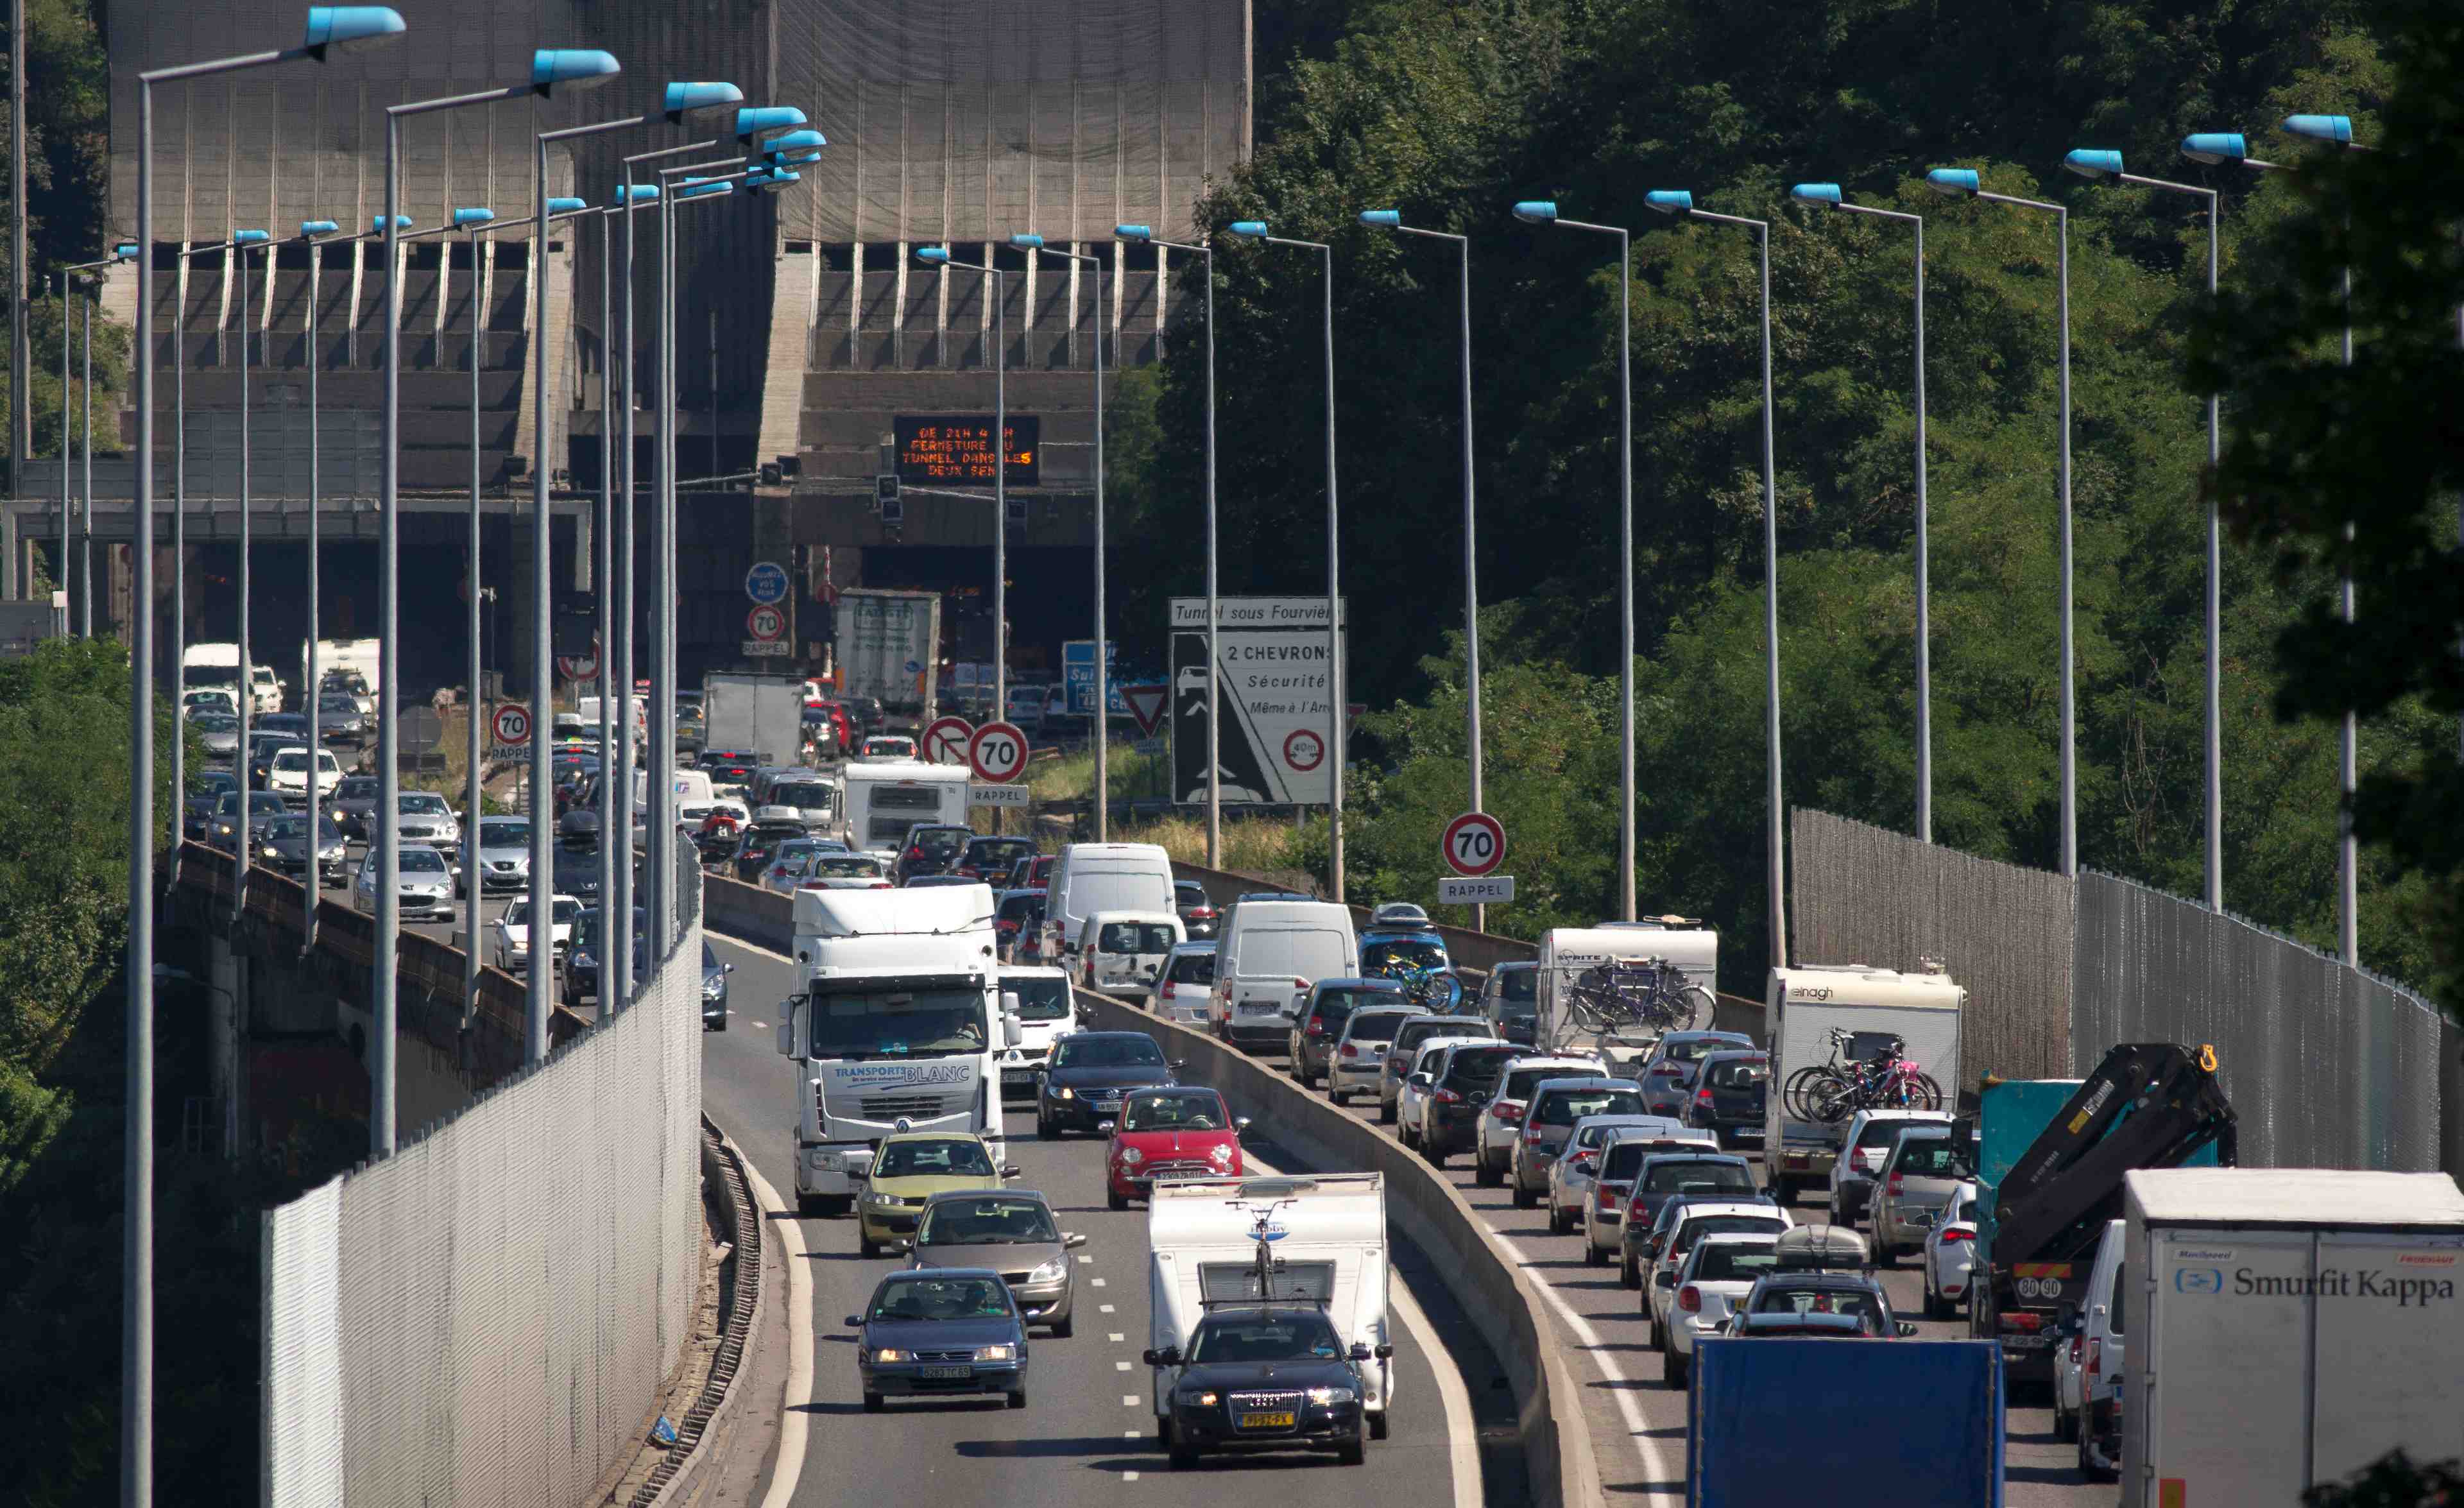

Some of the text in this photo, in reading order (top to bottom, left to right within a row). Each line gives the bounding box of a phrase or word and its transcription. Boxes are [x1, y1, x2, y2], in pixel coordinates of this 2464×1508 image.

[911, 440, 987, 452] FERMETURE
[903, 452, 955, 463] TUNNEL
[1002, 451, 1032, 465] LES
[970, 465, 1007, 476] SEN
[1176, 605, 1331, 620] Tunnl sous Fourvièr
[757, 616, 777, 631] 70
[1228, 646, 1238, 660] 2
[1247, 674, 1326, 688] Sécurité
[1250, 701, 1286, 714] Même
[1288, 703, 1296, 714] à
[502, 717, 524, 733] 70
[493, 748, 530, 760] RAPPE
[982, 741, 1015, 766] 70
[975, 791, 1021, 801] RAPPEL
[1457, 832, 1493, 858] 70
[1449, 886, 1503, 896] RAPPEL
[1790, 986, 1834, 1001] elnagh
[835, 1065, 970, 1083] TRANSPORTS BLANC
[1251, 1224, 1287, 1233] Hbby
[2021, 1280, 2058, 1295] 80 90
[2234, 1267, 2454, 1308] Smurfit Kappa
